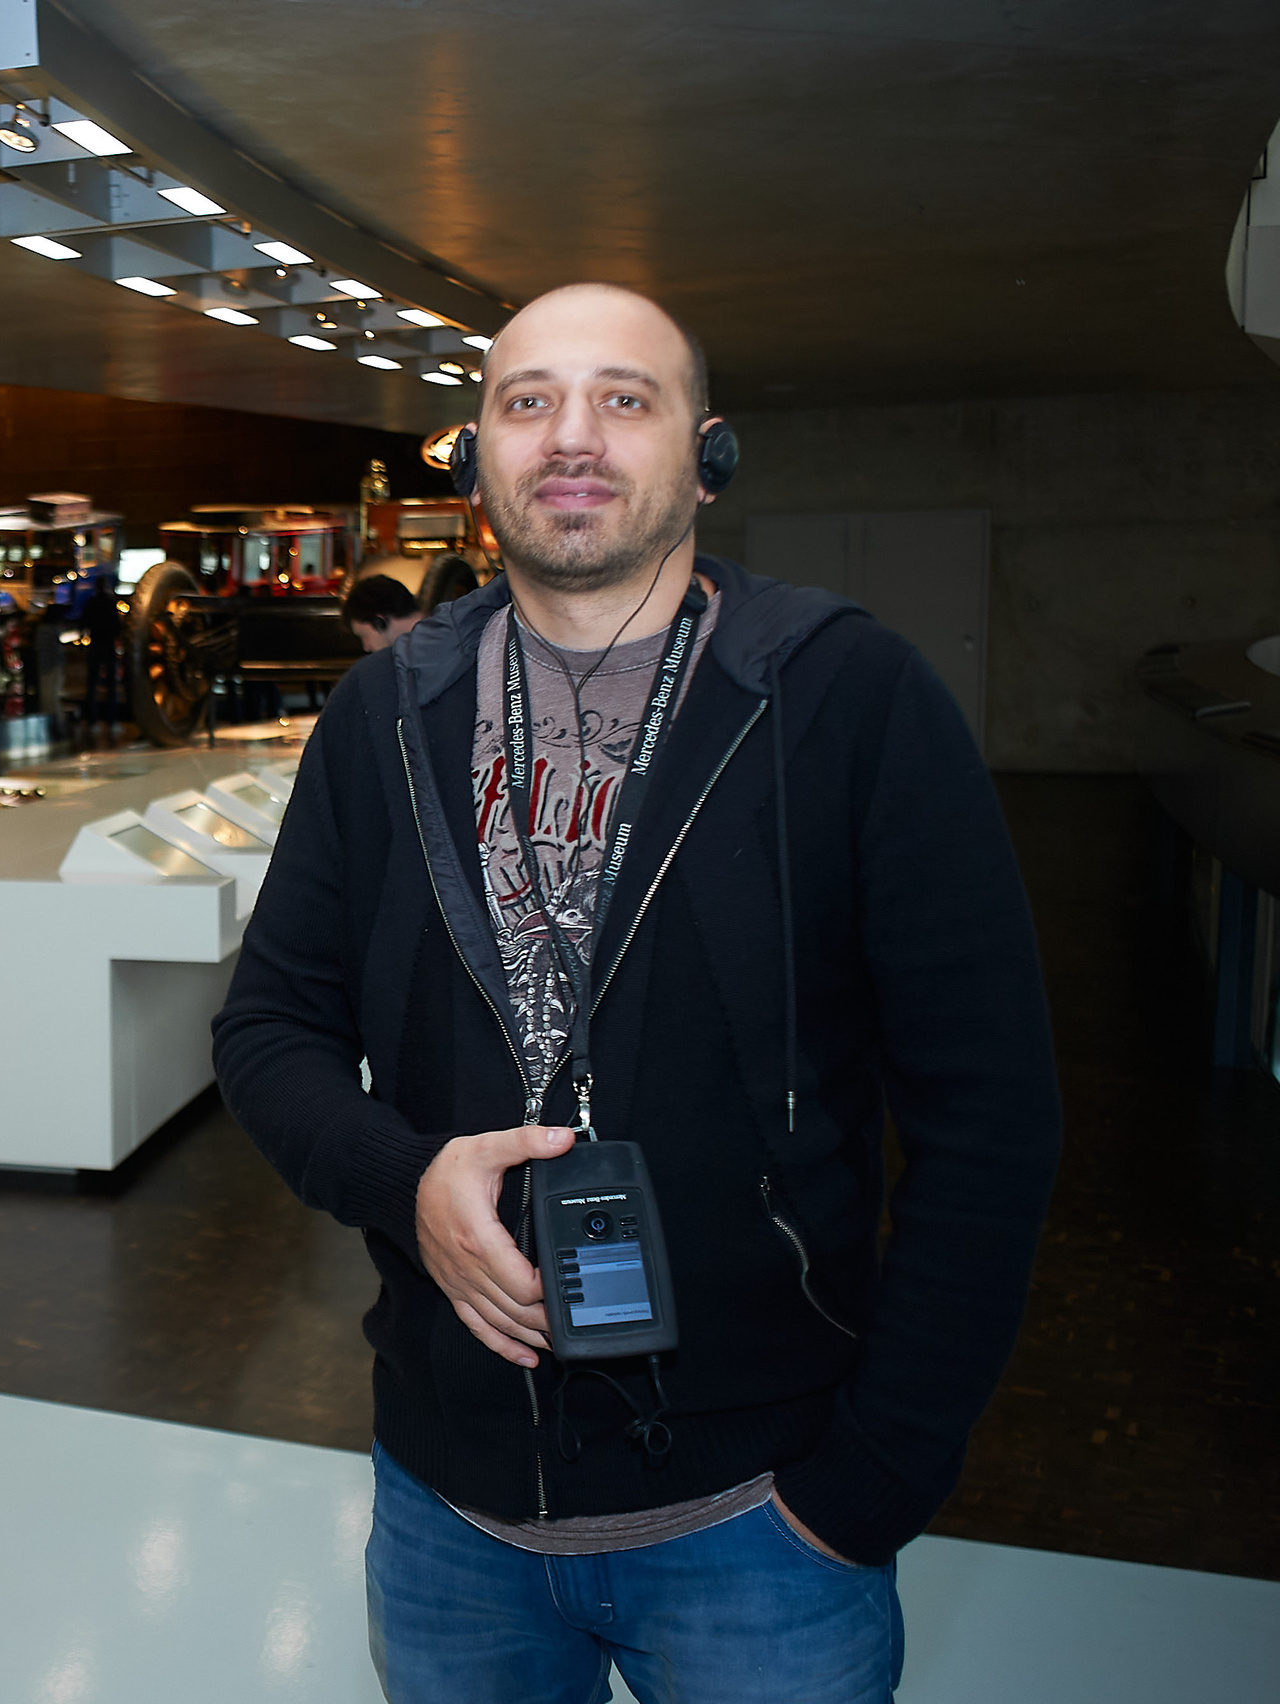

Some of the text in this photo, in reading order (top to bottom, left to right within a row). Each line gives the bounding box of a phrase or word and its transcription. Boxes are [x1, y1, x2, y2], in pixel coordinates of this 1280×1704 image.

[507, 638, 525, 789] Mercedes-Benz Museum
[631, 617, 693, 776] Mercedes-Benz Museum
[603, 822, 632, 886] Museum
